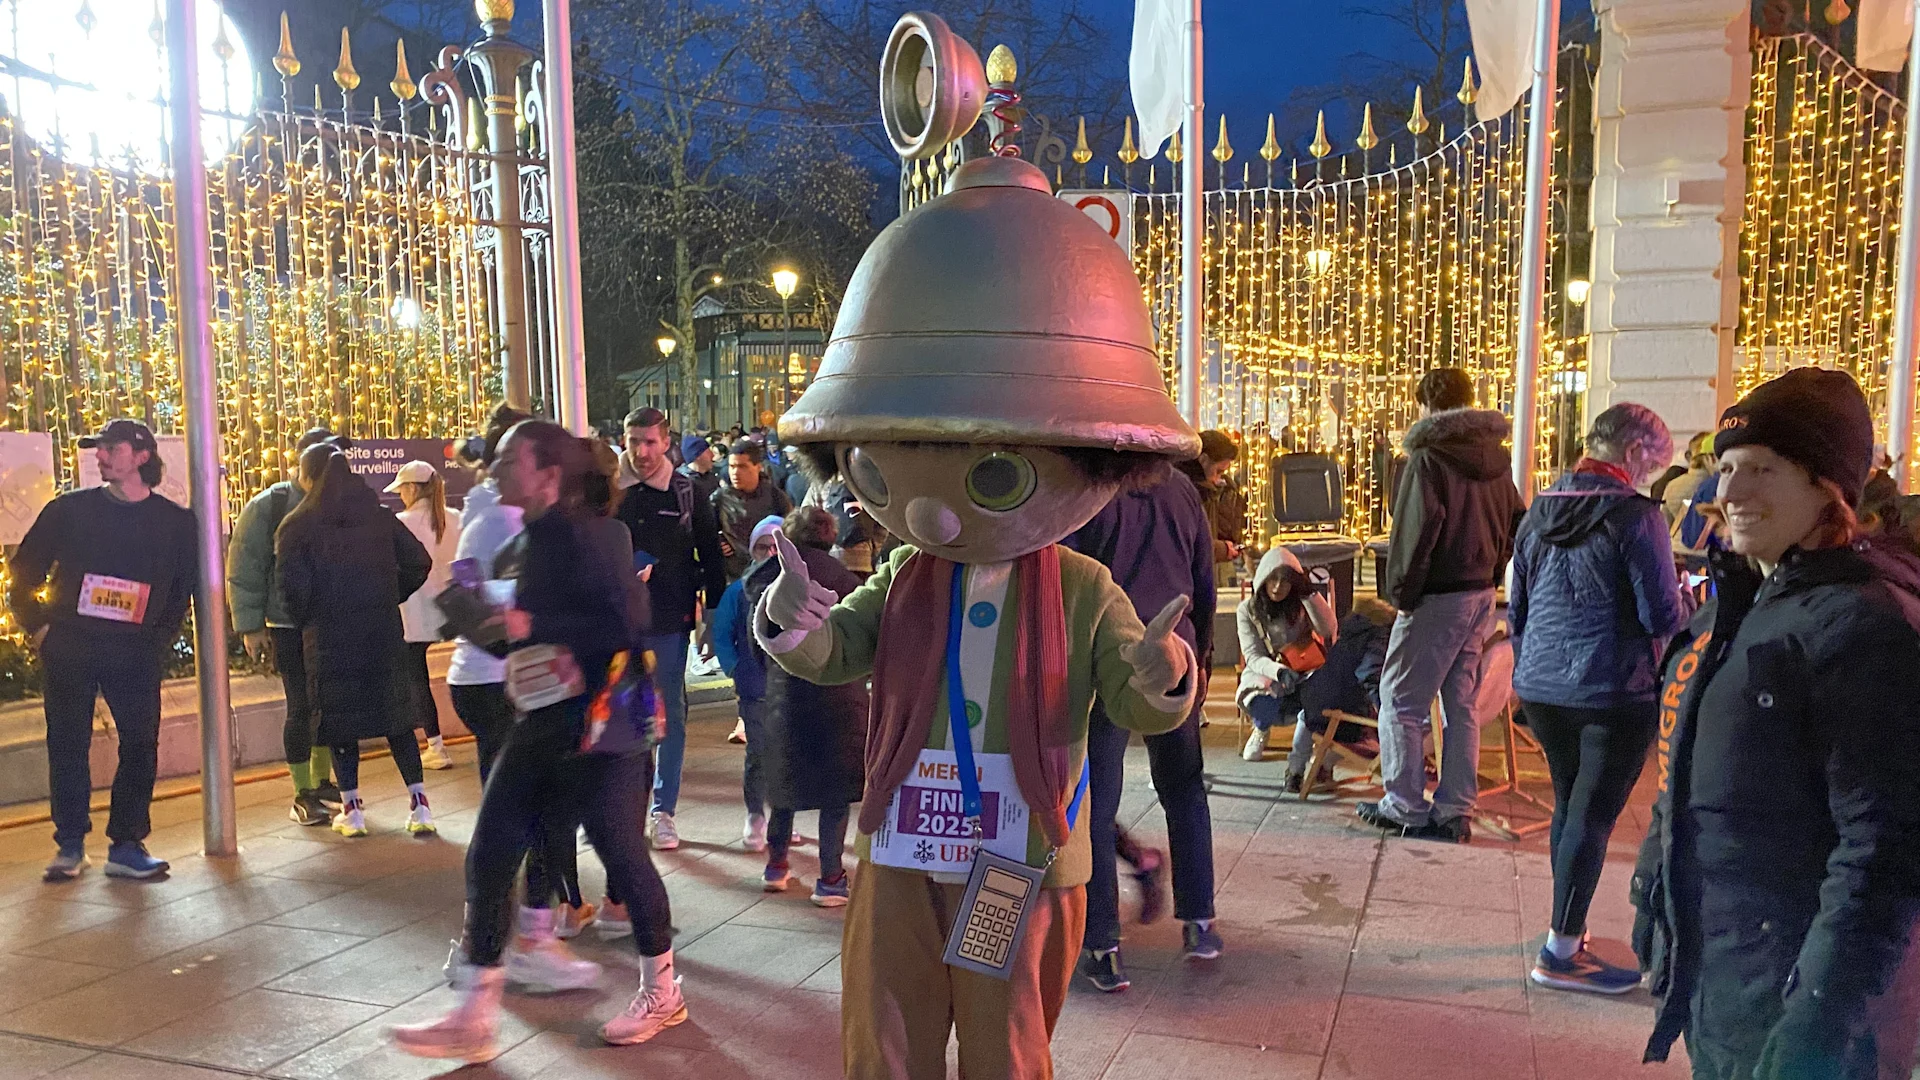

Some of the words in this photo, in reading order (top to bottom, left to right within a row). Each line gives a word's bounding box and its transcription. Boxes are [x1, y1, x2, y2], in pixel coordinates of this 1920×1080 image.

[344, 446, 371, 460] Site
[373, 448, 405, 459] sous
[350, 461, 405, 474] urveilla
[1658, 630, 1712, 793] MIGROS
[918, 761, 983, 783] MERI
[916, 813, 974, 837] 2025
